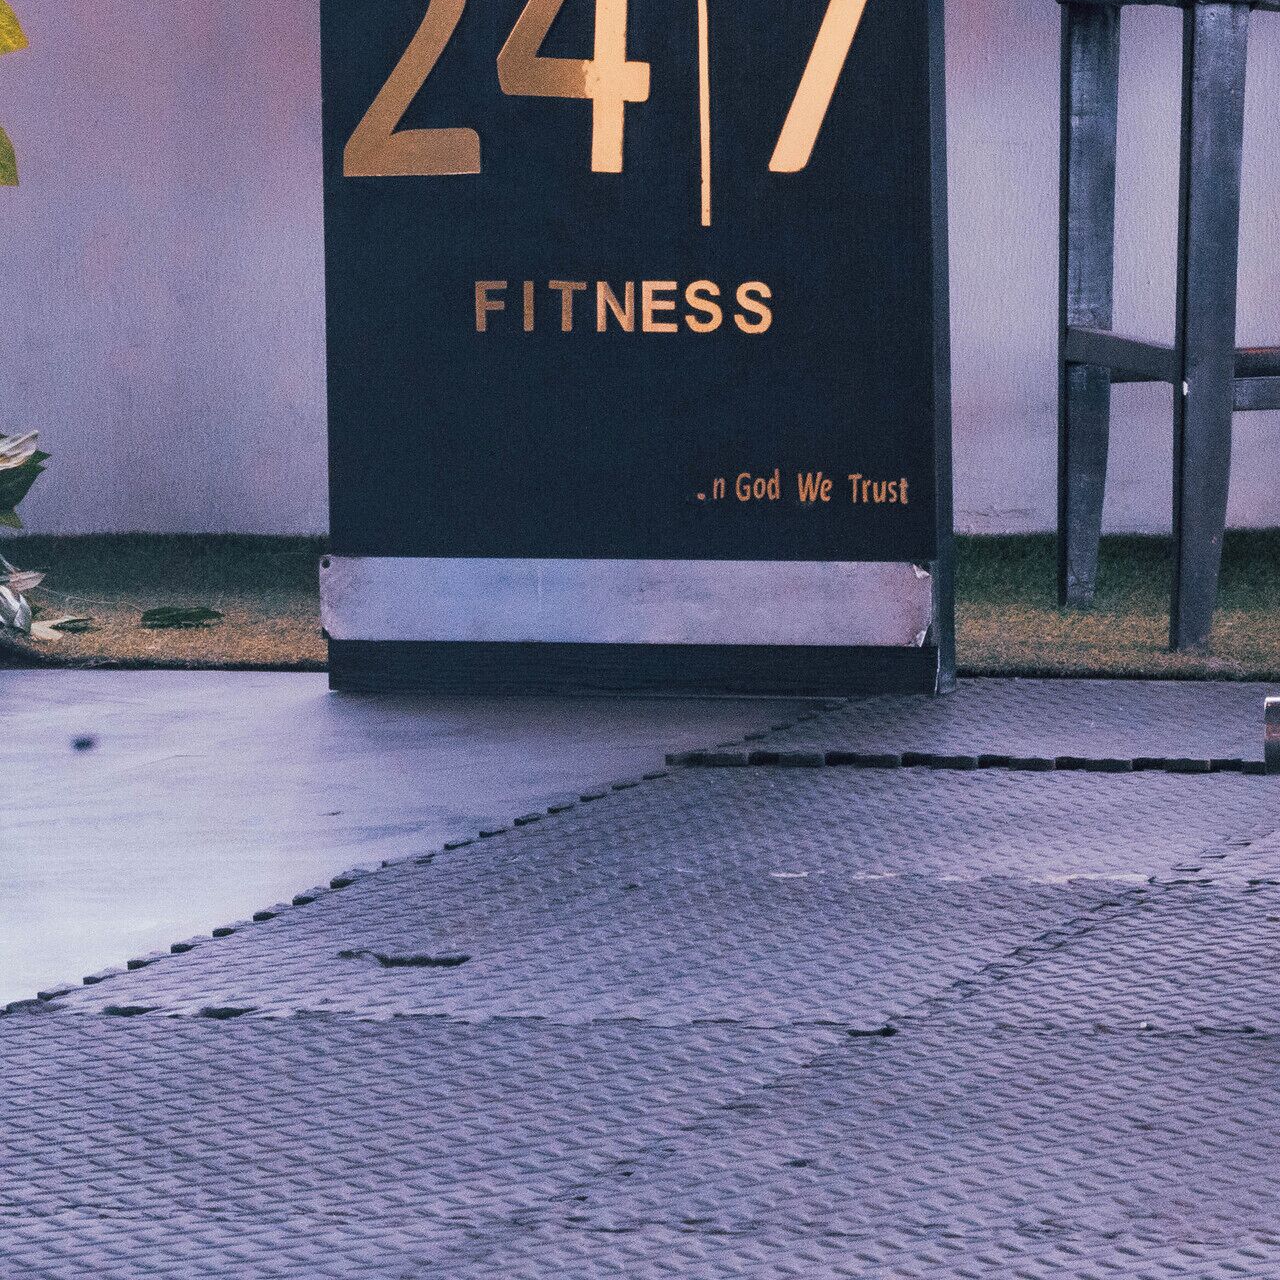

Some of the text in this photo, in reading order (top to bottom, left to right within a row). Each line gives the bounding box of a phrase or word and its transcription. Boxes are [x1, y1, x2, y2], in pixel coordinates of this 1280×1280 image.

[475, 279, 774, 334] FITNESS
[735, 469, 781, 502] God
[797, 472, 833, 503] We
[848, 474, 909, 504] Trust
